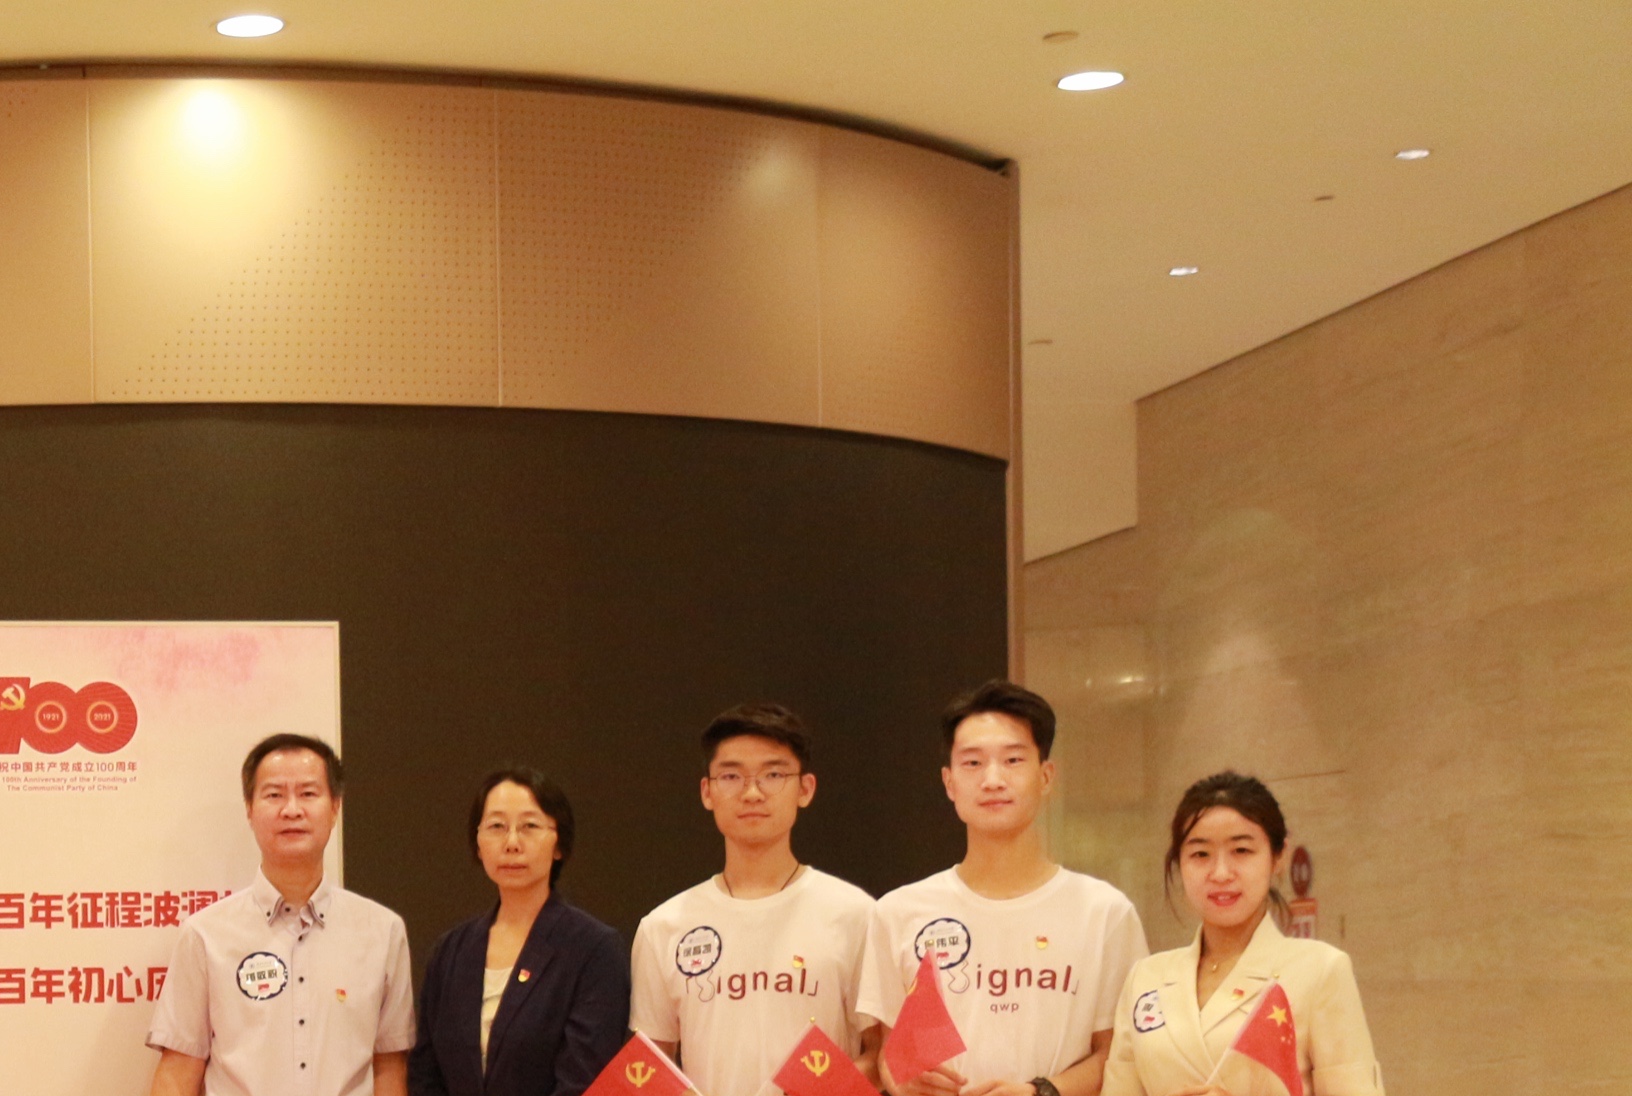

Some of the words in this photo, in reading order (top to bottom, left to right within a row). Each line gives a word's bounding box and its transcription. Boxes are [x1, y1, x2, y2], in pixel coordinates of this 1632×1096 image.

[42, 712, 60, 721] 1921
[93, 712, 111, 721] 2021
[23, 776, 67, 784] Anniversary
[93, 776, 127, 784] Founding
[67, 785, 85, 793] Party
[989, 1002, 1020, 1014] qwp
